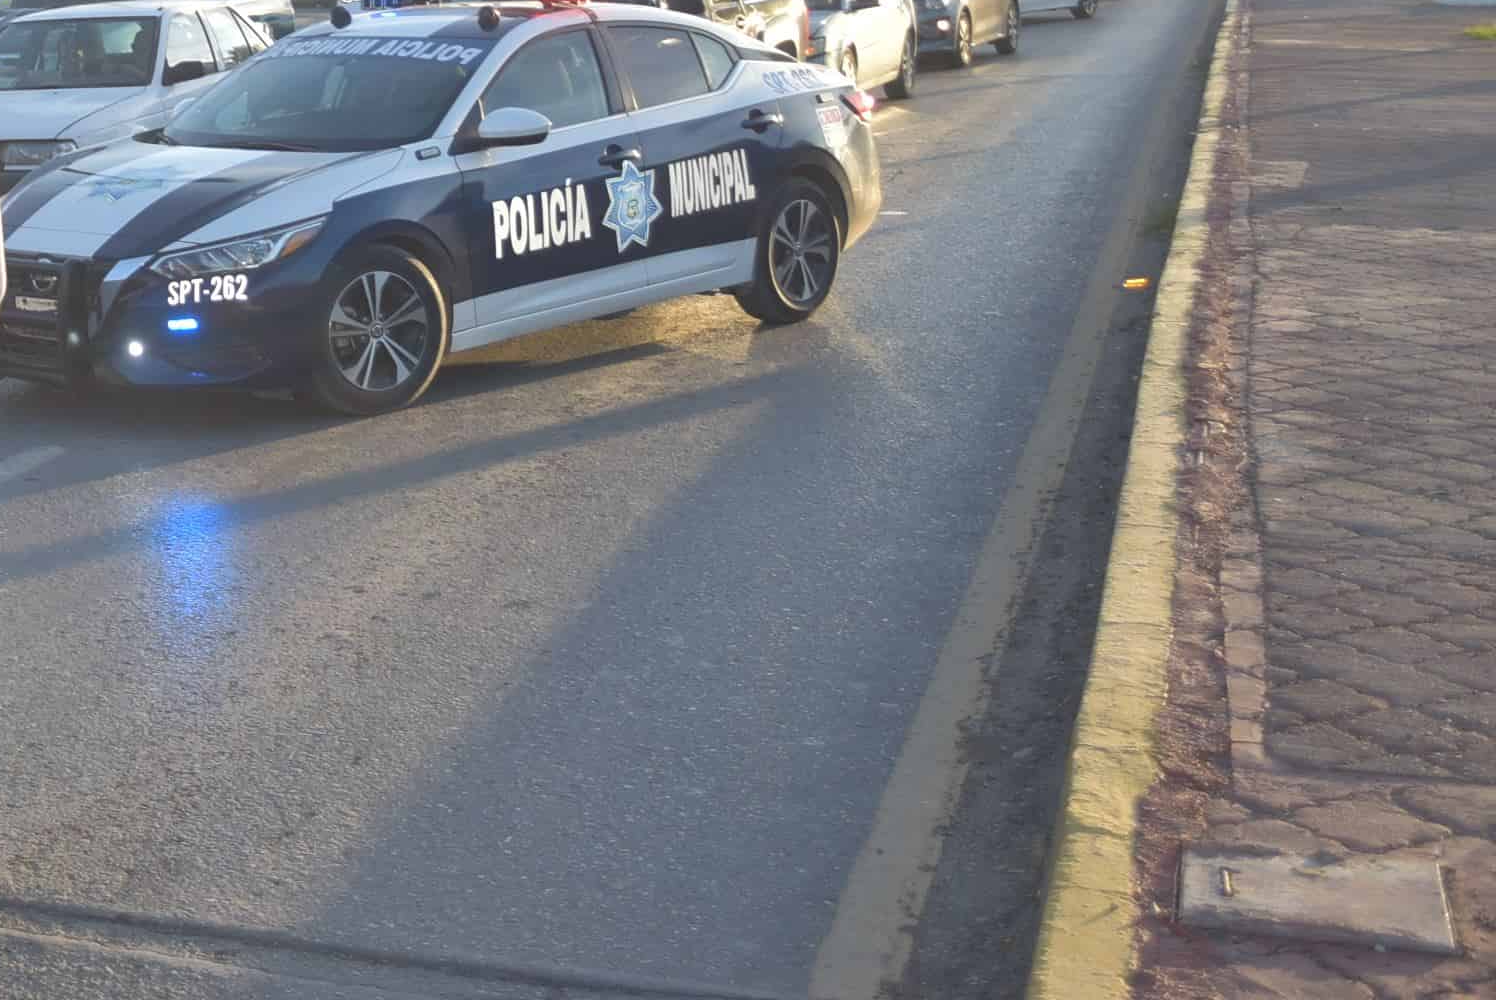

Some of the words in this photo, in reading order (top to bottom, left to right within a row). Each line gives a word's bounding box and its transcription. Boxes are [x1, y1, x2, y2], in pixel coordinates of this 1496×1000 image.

[668, 149, 756, 218] MUNICIPAL
[492, 178, 592, 259] POLICÍA
[167, 274, 249, 306] SPT-262
